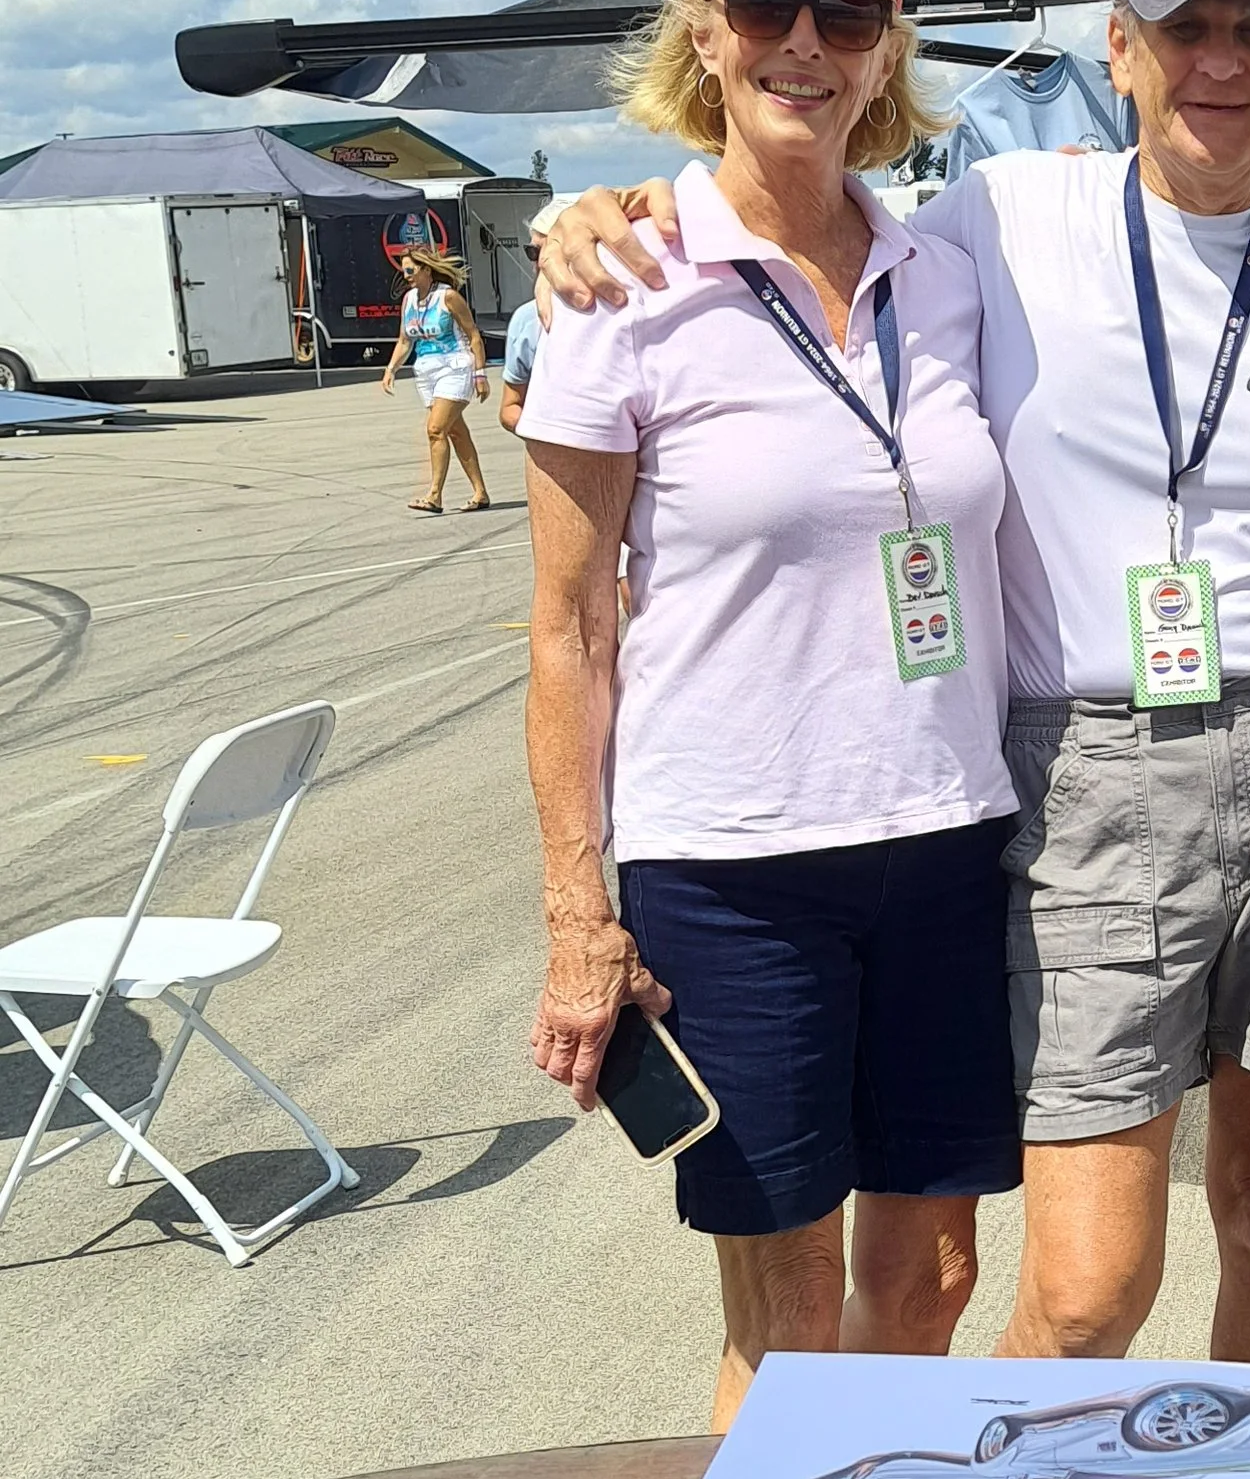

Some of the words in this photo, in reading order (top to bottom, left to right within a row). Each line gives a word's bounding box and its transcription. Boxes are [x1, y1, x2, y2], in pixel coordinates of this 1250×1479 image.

[771, 299, 802, 335] REUNION
[799, 333, 810, 345] GT
[806, 343, 837, 382] 1964-2024
